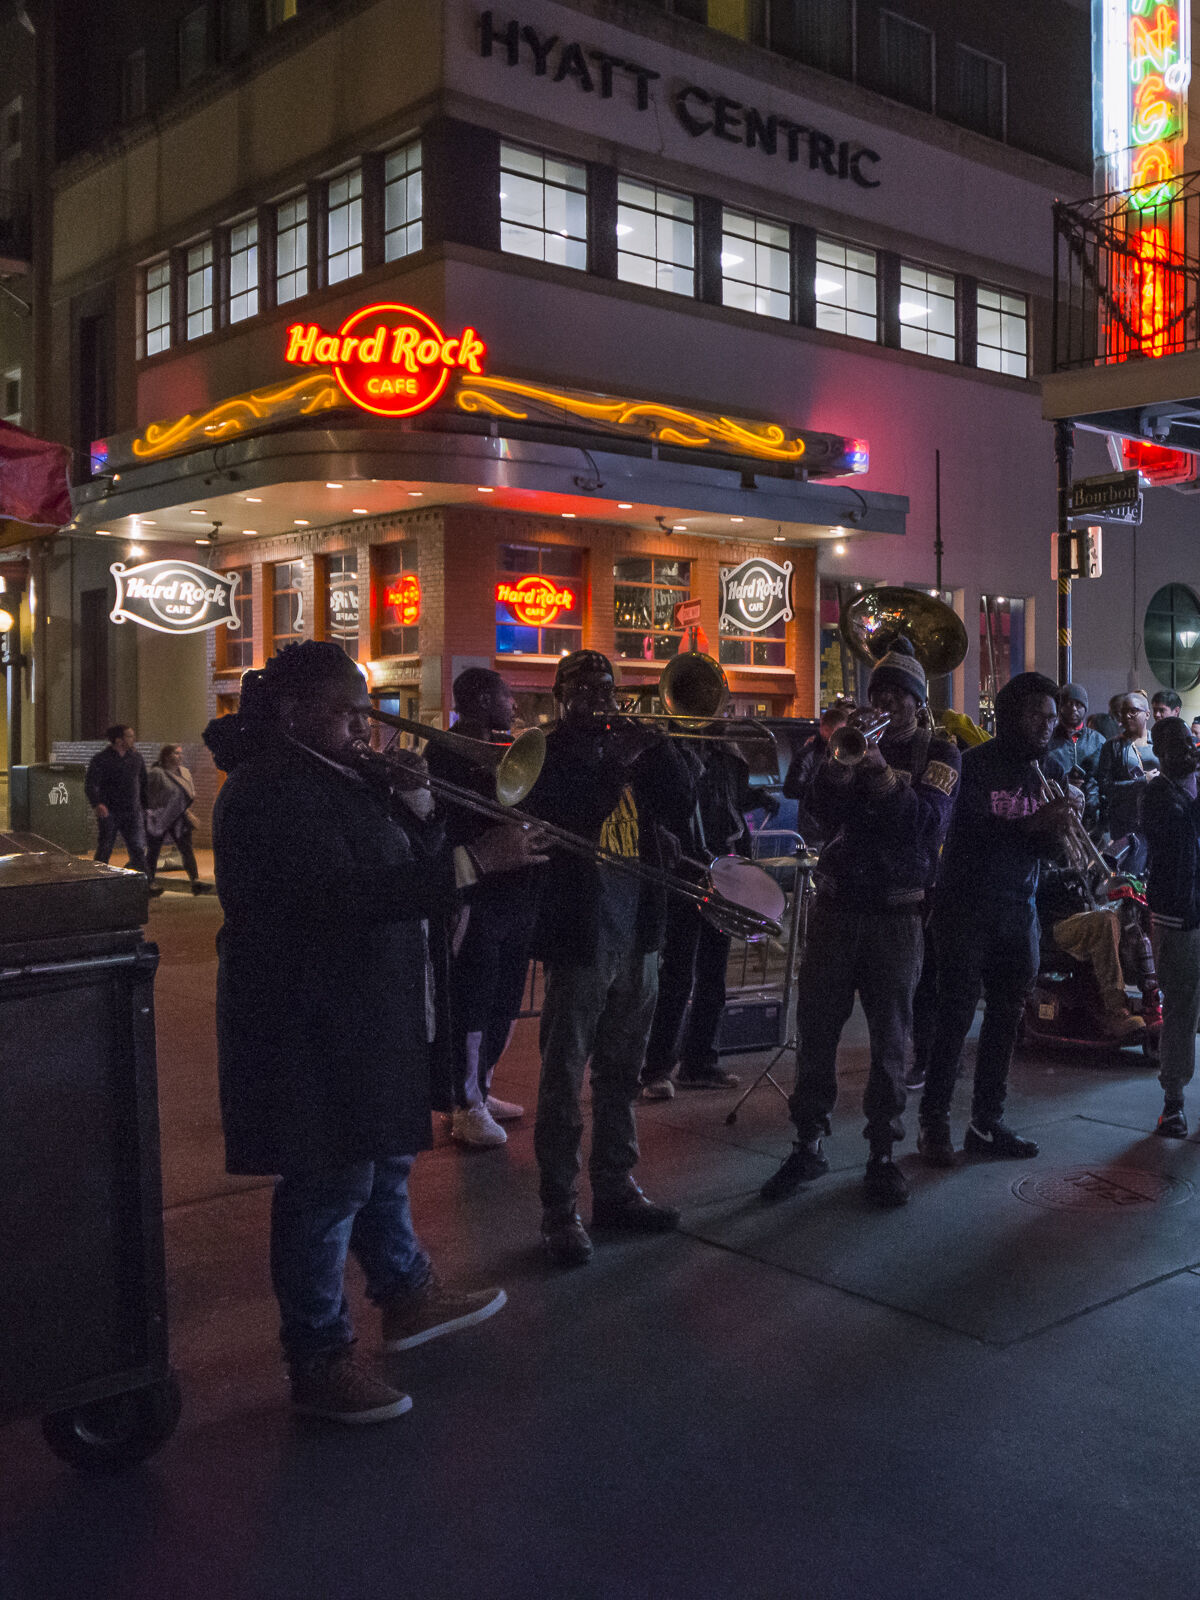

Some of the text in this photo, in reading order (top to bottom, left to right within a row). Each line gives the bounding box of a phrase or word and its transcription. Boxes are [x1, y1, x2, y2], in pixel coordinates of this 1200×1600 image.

[479, 11, 882, 188] HYATT CENTRIC
[285, 324, 485, 374] Hard Rock
[366, 377, 418, 395] CAFE
[1075, 485, 1136, 506] Bourbon
[126, 577, 226, 606] Hard Rock
[497, 585, 573, 609] Hard Rock
[728, 575, 784, 600] Hard Rock
[165, 604, 192, 615] CAFE
[748, 602, 764, 612] CAFE
